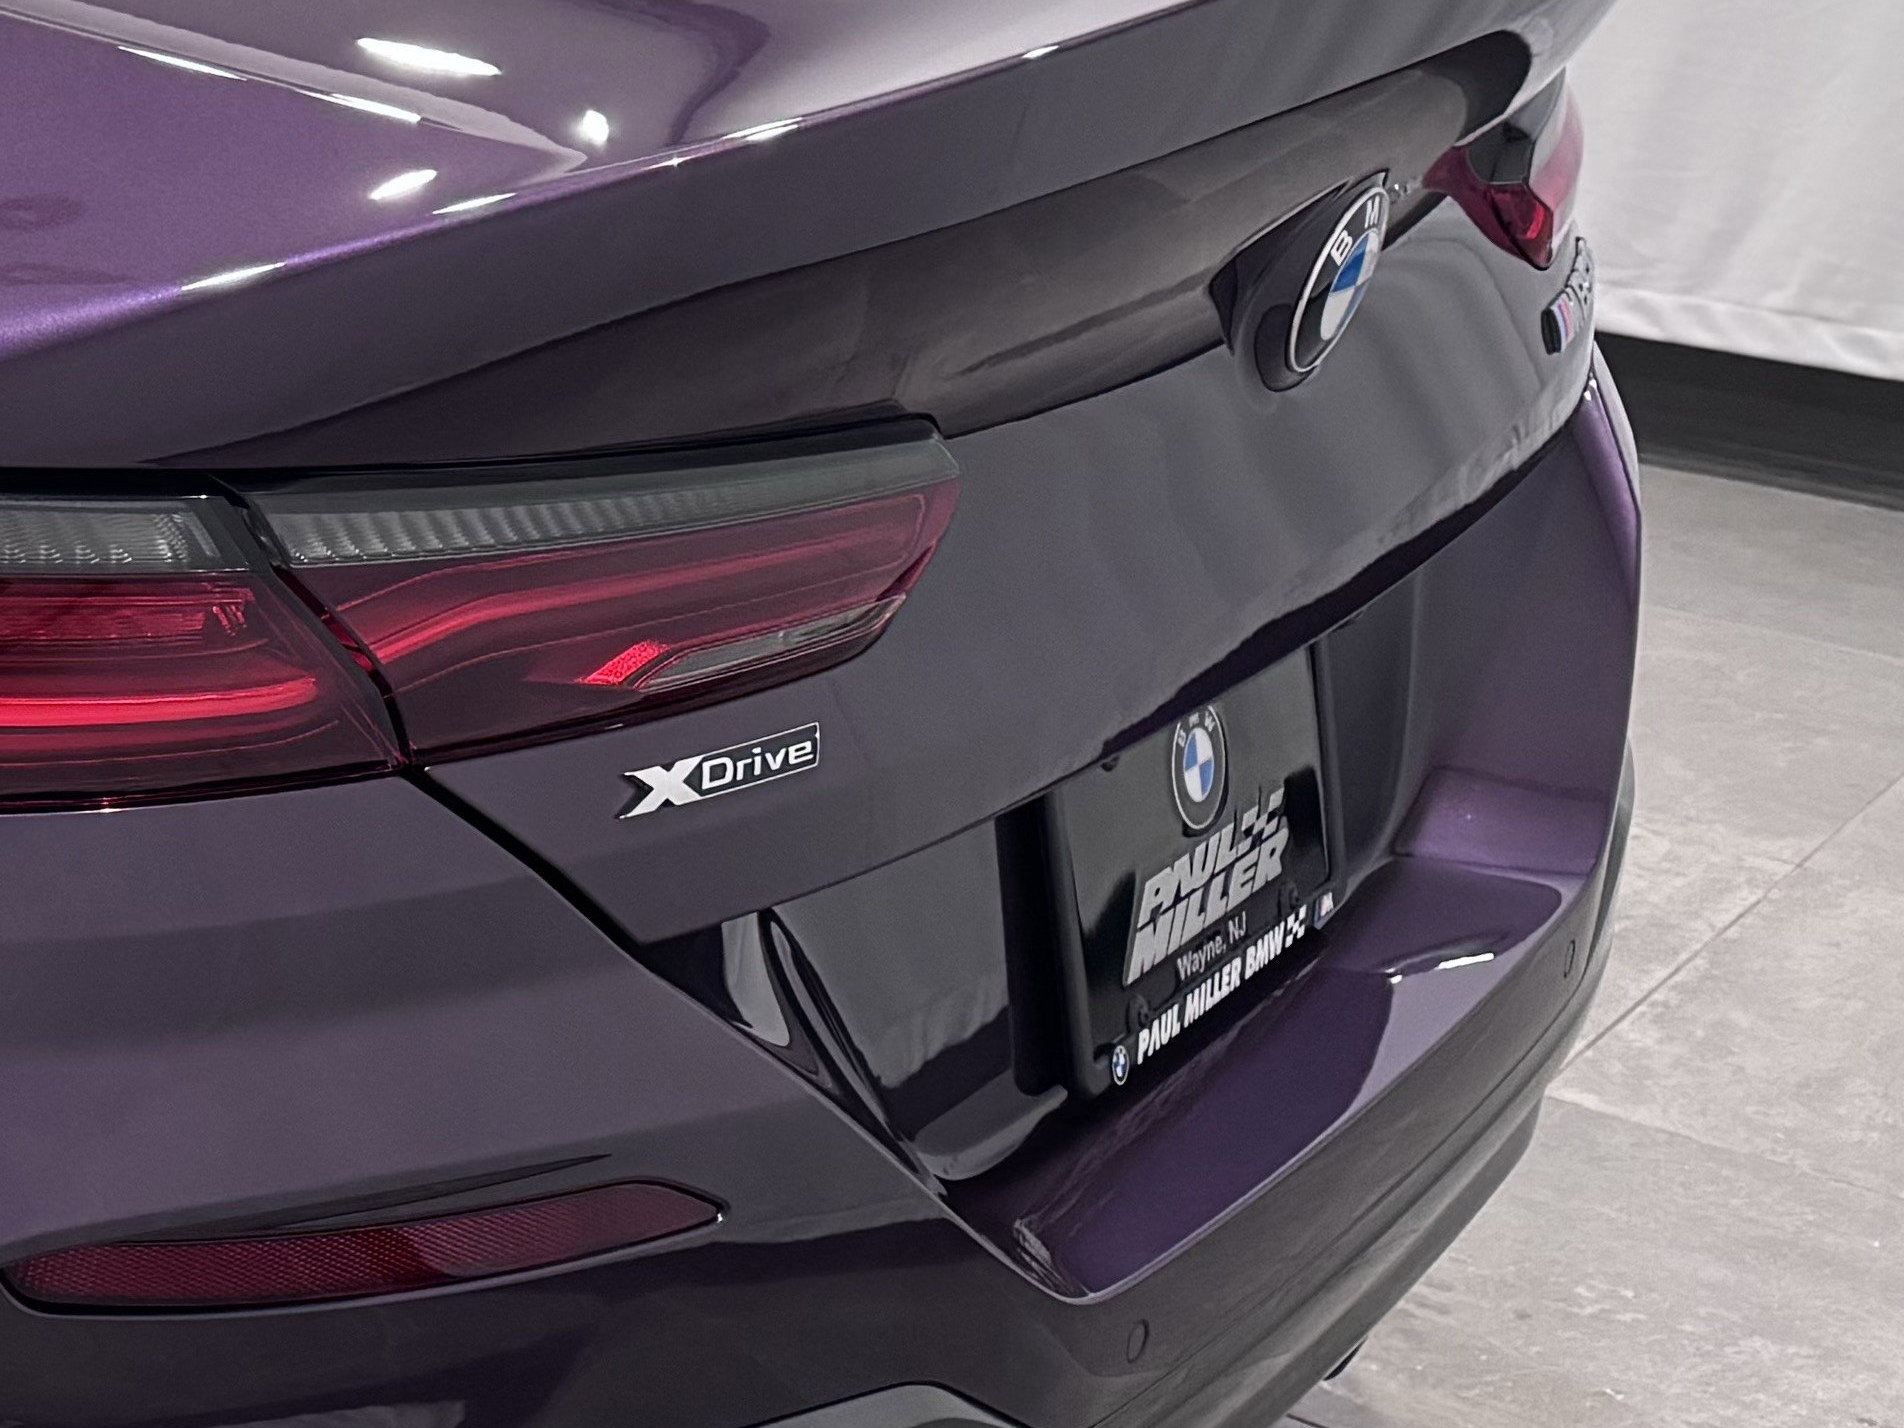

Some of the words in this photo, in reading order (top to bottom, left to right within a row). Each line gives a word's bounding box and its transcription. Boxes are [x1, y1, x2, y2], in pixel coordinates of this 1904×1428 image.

[1126, 826, 1290, 987] MILLER
[1136, 821, 1238, 930] PAUL
[1137, 1003, 1182, 1066] PAUL
[1183, 956, 1243, 1029] MILLER
[1244, 920, 1287, 981] BMW
[1176, 933, 1227, 981] Wayne,
[1228, 910, 1247, 945] NJ
